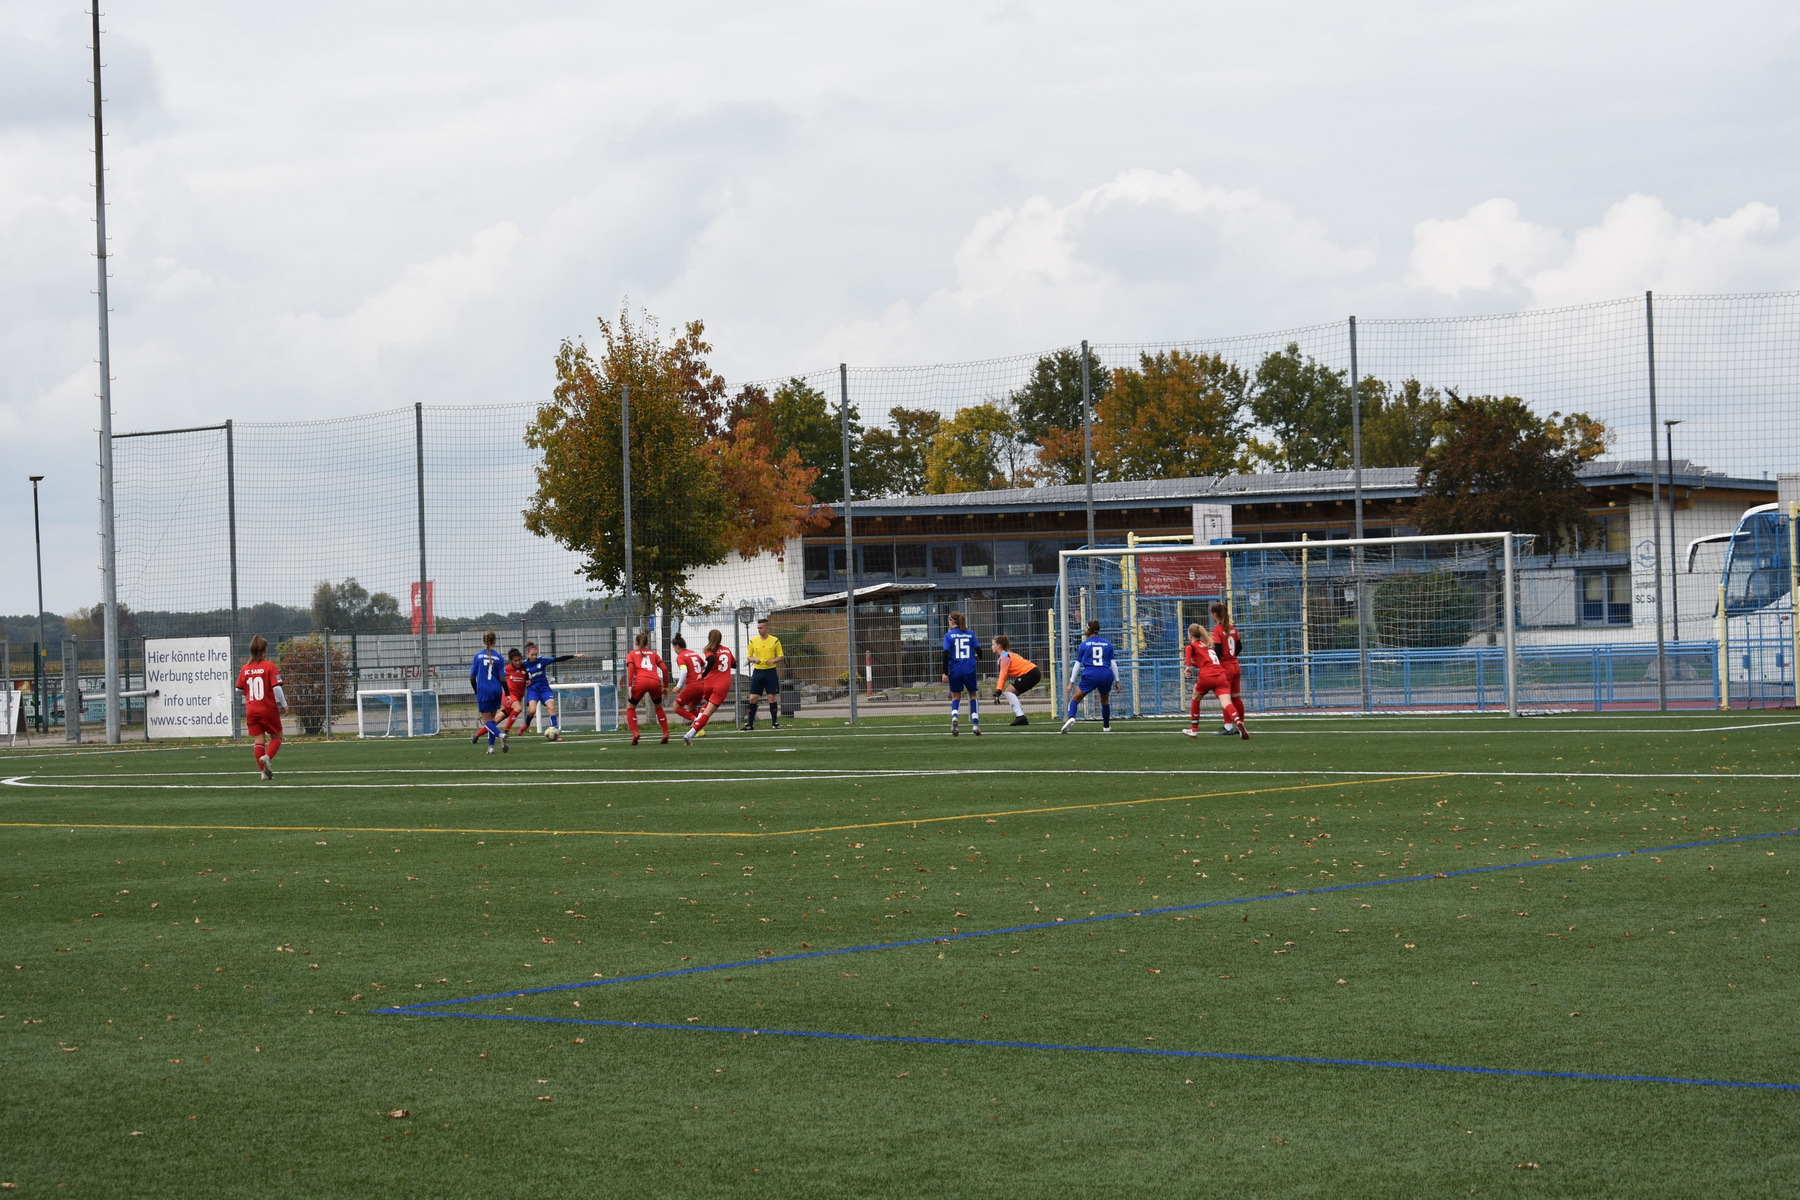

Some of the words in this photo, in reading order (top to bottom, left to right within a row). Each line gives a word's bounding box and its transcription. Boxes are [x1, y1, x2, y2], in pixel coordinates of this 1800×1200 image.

[954, 638, 970, 659] 15
[1227, 635, 1235, 656] 9
[147, 650, 170, 663] Hier
[171, 650, 206, 662] könnte
[207, 649, 228, 661] Ihre
[641, 655, 653, 671] 4
[690, 656, 702, 674] 5
[717, 654, 729, 672] 3
[1092, 646, 1103, 666] 9
[147, 669, 193, 684] Werbung
[195, 668, 229, 681] stehen
[400, 665, 436, 678] TEUEL
[483, 659, 494, 680] 7
[246, 676, 265, 701] 10
[164, 694, 184, 706] info
[186, 695, 212, 706] unter
[150, 712, 229, 726] www.sc-sand.de
